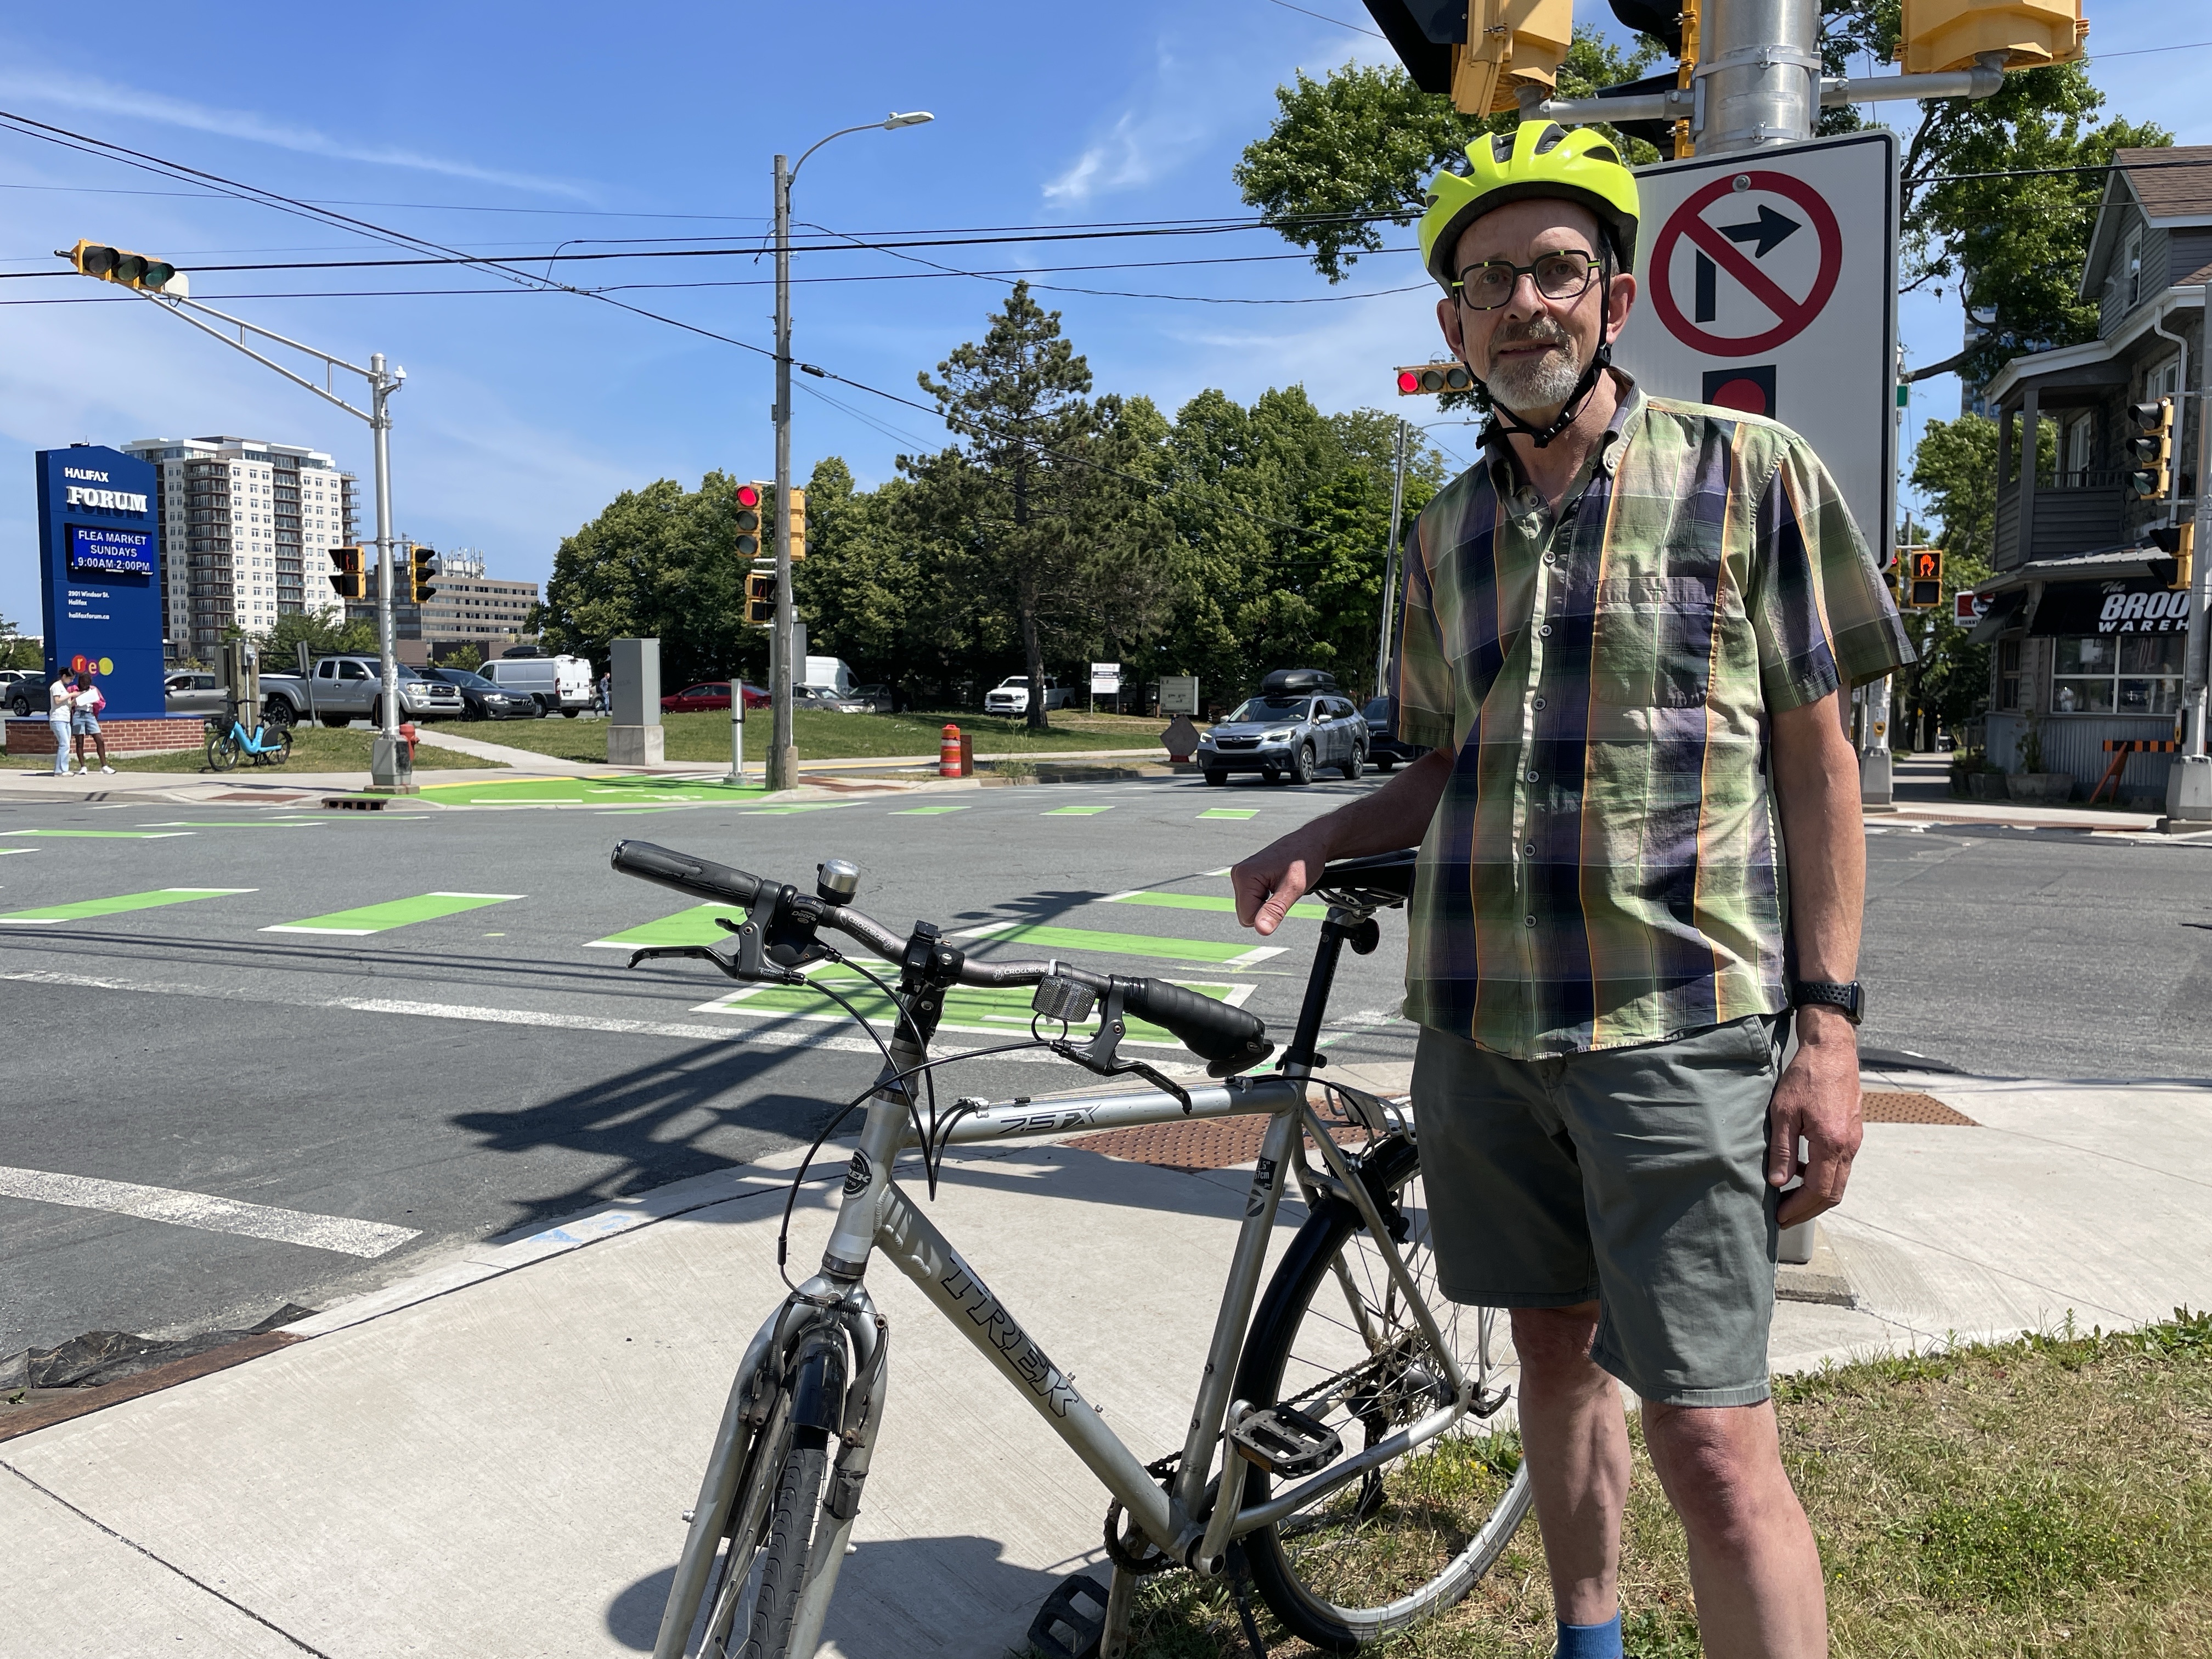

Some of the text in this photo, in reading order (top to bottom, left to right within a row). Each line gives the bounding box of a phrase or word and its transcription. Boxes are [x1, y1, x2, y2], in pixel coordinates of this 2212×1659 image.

[65, 467, 109, 483] HALIFAX
[66, 486, 148, 512] FORUM
[78, 530, 147, 545] FLEA MARKET
[91, 544, 137, 557] SUNDAYS
[78, 557, 150, 571] 9:00AM-2:00PM
[848, 1167, 871, 1183] REK
[941, 1256, 1079, 1418] TREK
